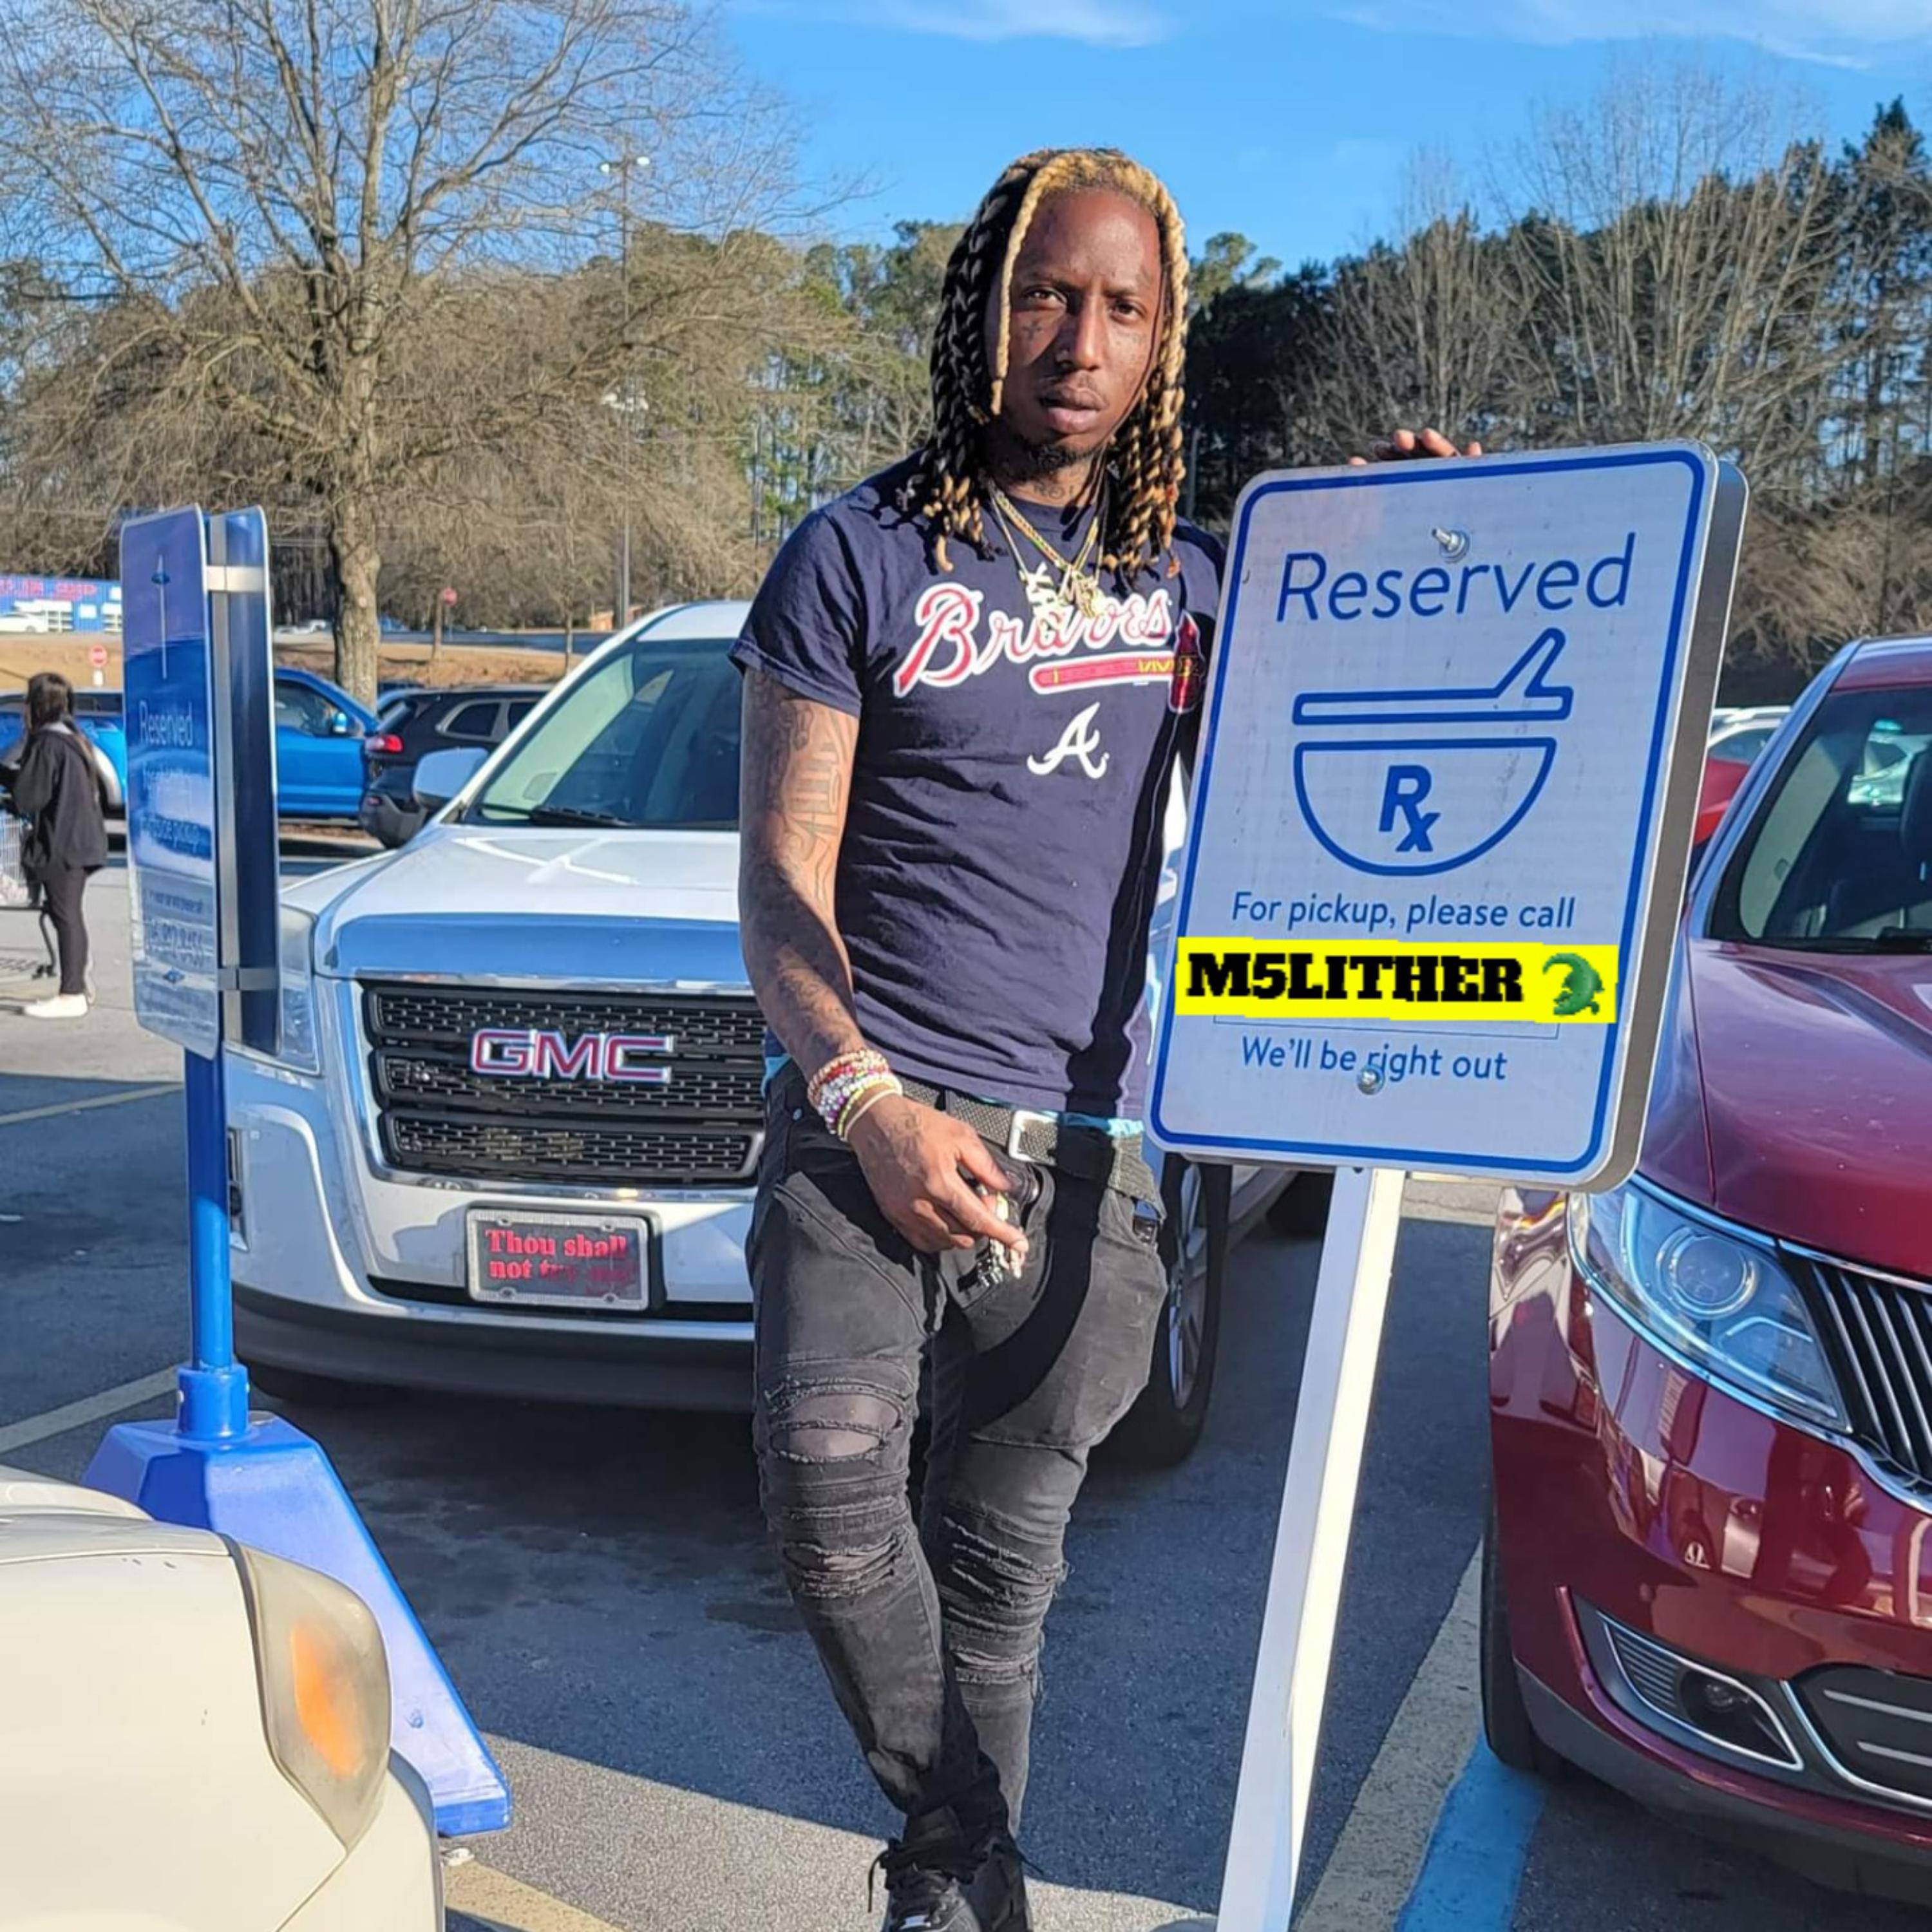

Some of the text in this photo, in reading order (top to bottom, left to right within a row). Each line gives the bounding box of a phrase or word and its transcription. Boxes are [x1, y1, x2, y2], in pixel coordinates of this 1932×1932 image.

[1276, 531, 1636, 623] Reserved
[893, 583, 1173, 697] Braves
[138, 701, 193, 746] Reserved
[1027, 703, 1110, 778] A
[1231, 891, 1576, 933] For pickup, please call
[471, 1028, 675, 1084] GMC
[1242, 1036, 1508, 1082] We'll be right out
[485, 1229, 627, 1258] Thou shall
[489, 1258, 533, 1279] not
